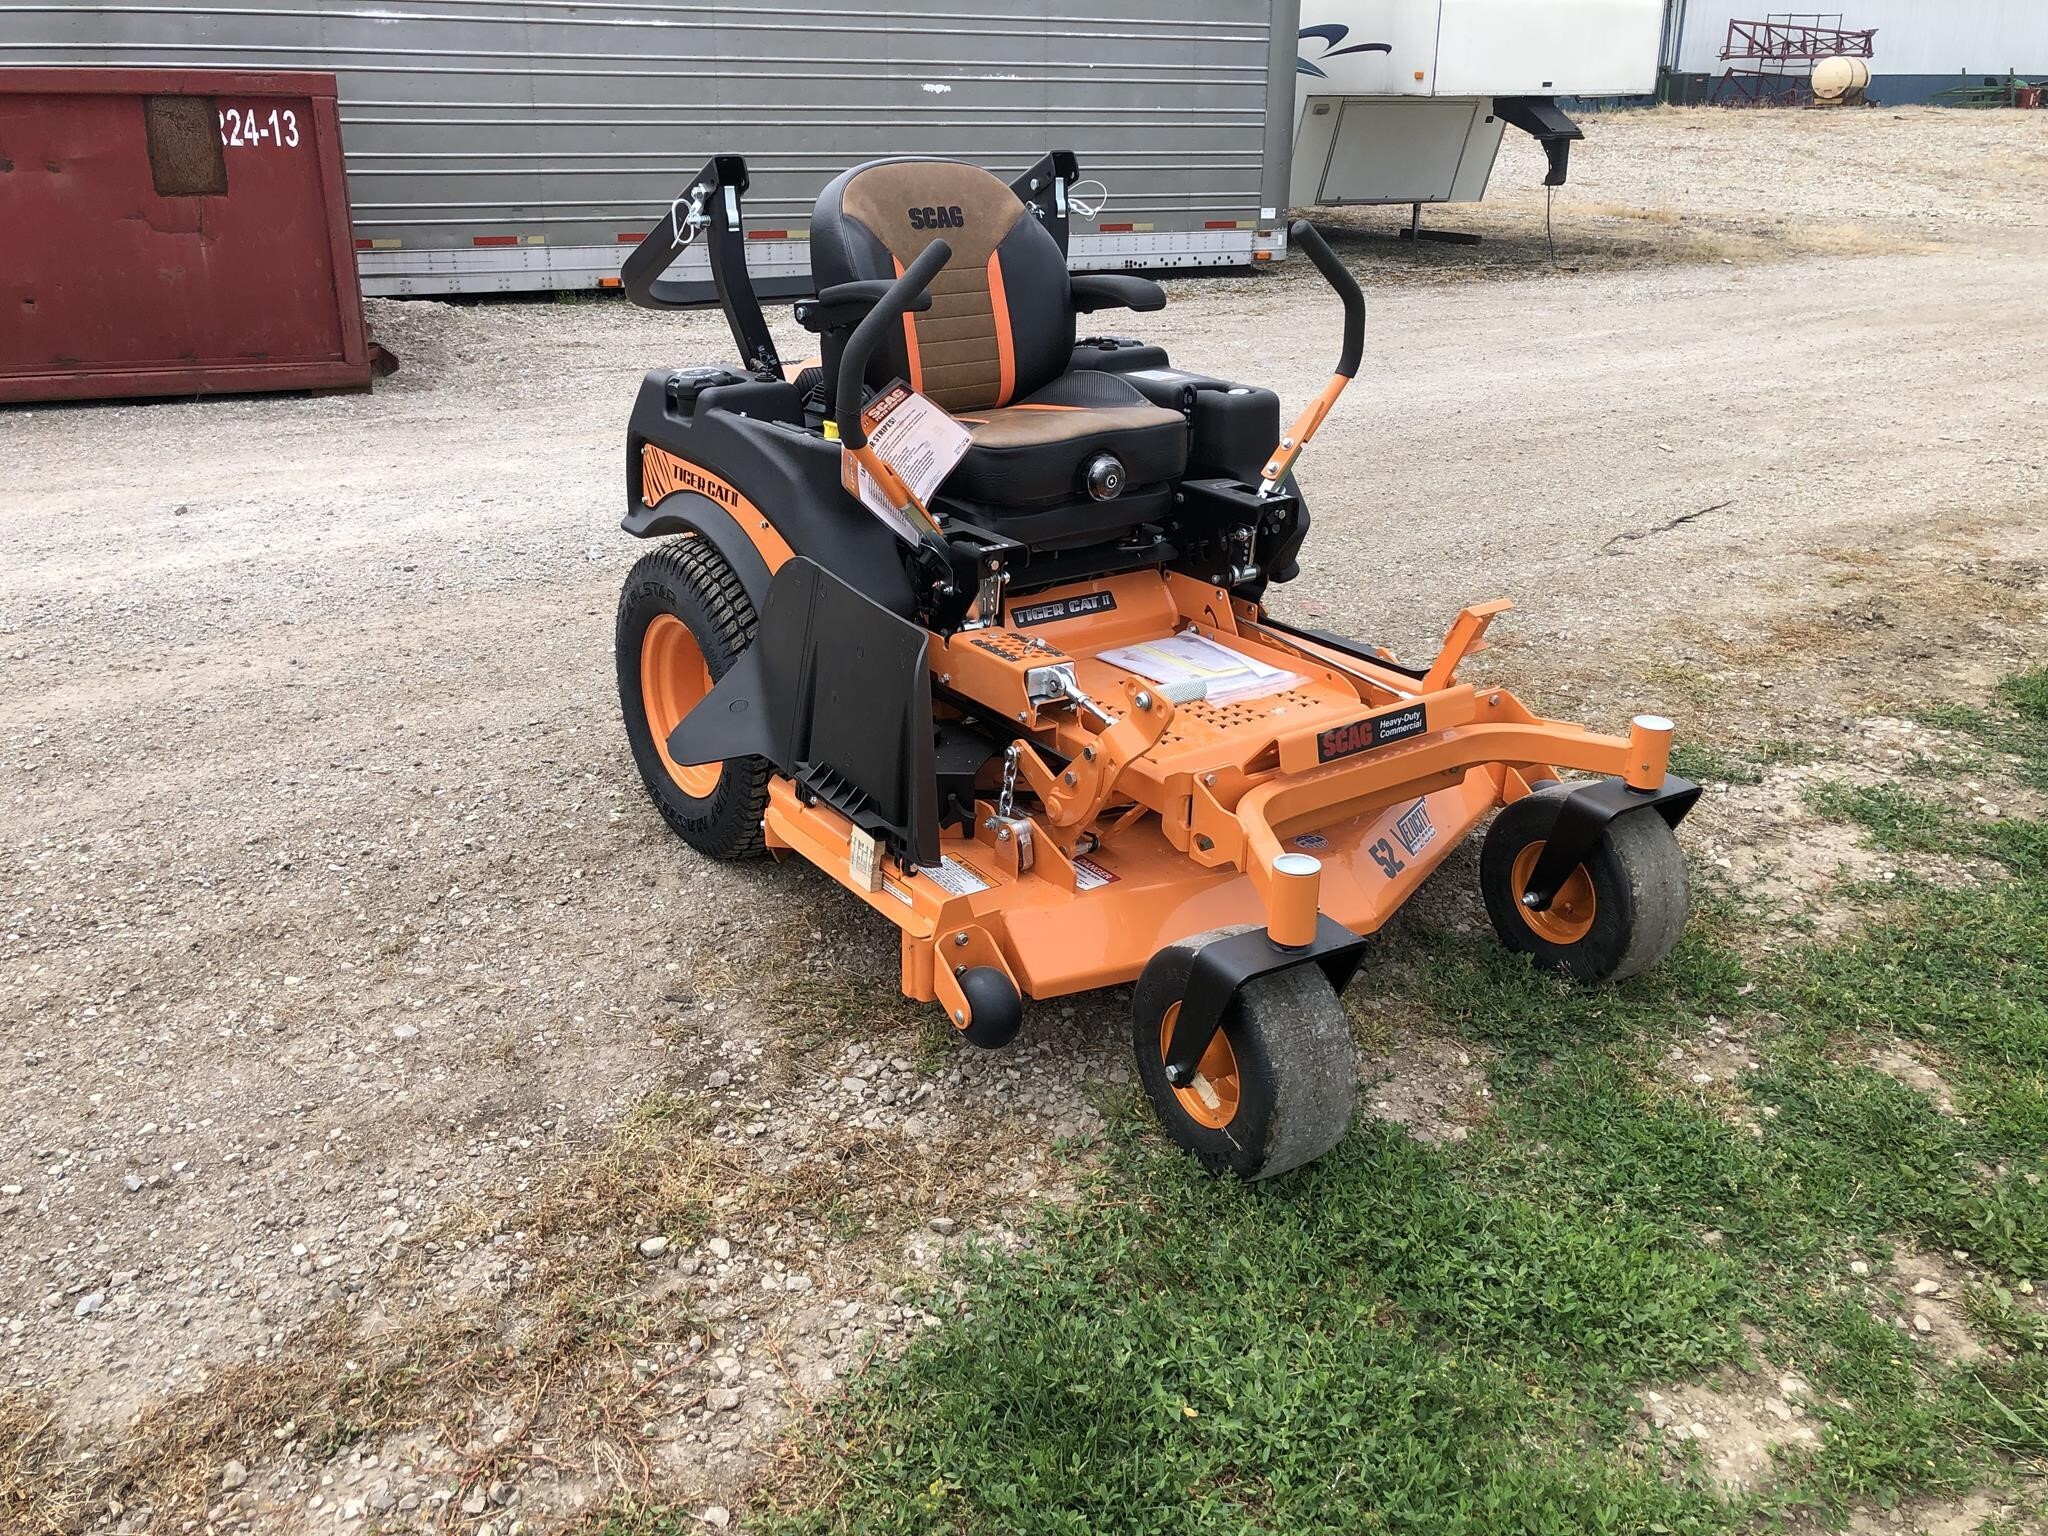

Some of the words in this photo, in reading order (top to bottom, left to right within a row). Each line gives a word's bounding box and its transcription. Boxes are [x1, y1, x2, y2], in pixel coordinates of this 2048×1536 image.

[908, 205, 964, 230] SCAG
[867, 388, 905, 419] SCAG
[872, 417, 897, 444] STRIPES!
[672, 463, 706, 493] TIGER
[707, 480, 730, 503] CAT
[1013, 603, 1065, 623] TIGER
[1068, 595, 1100, 613] CAT
[1102, 594, 1112, 606] II
[1379, 719, 1423, 739] Commercial
[1380, 710, 1421, 730] Heavy-Duty
[1322, 722, 1374, 757] SCAG
[1368, 837, 1406, 880] 52
[1389, 796, 1433, 857] VELOCITY
